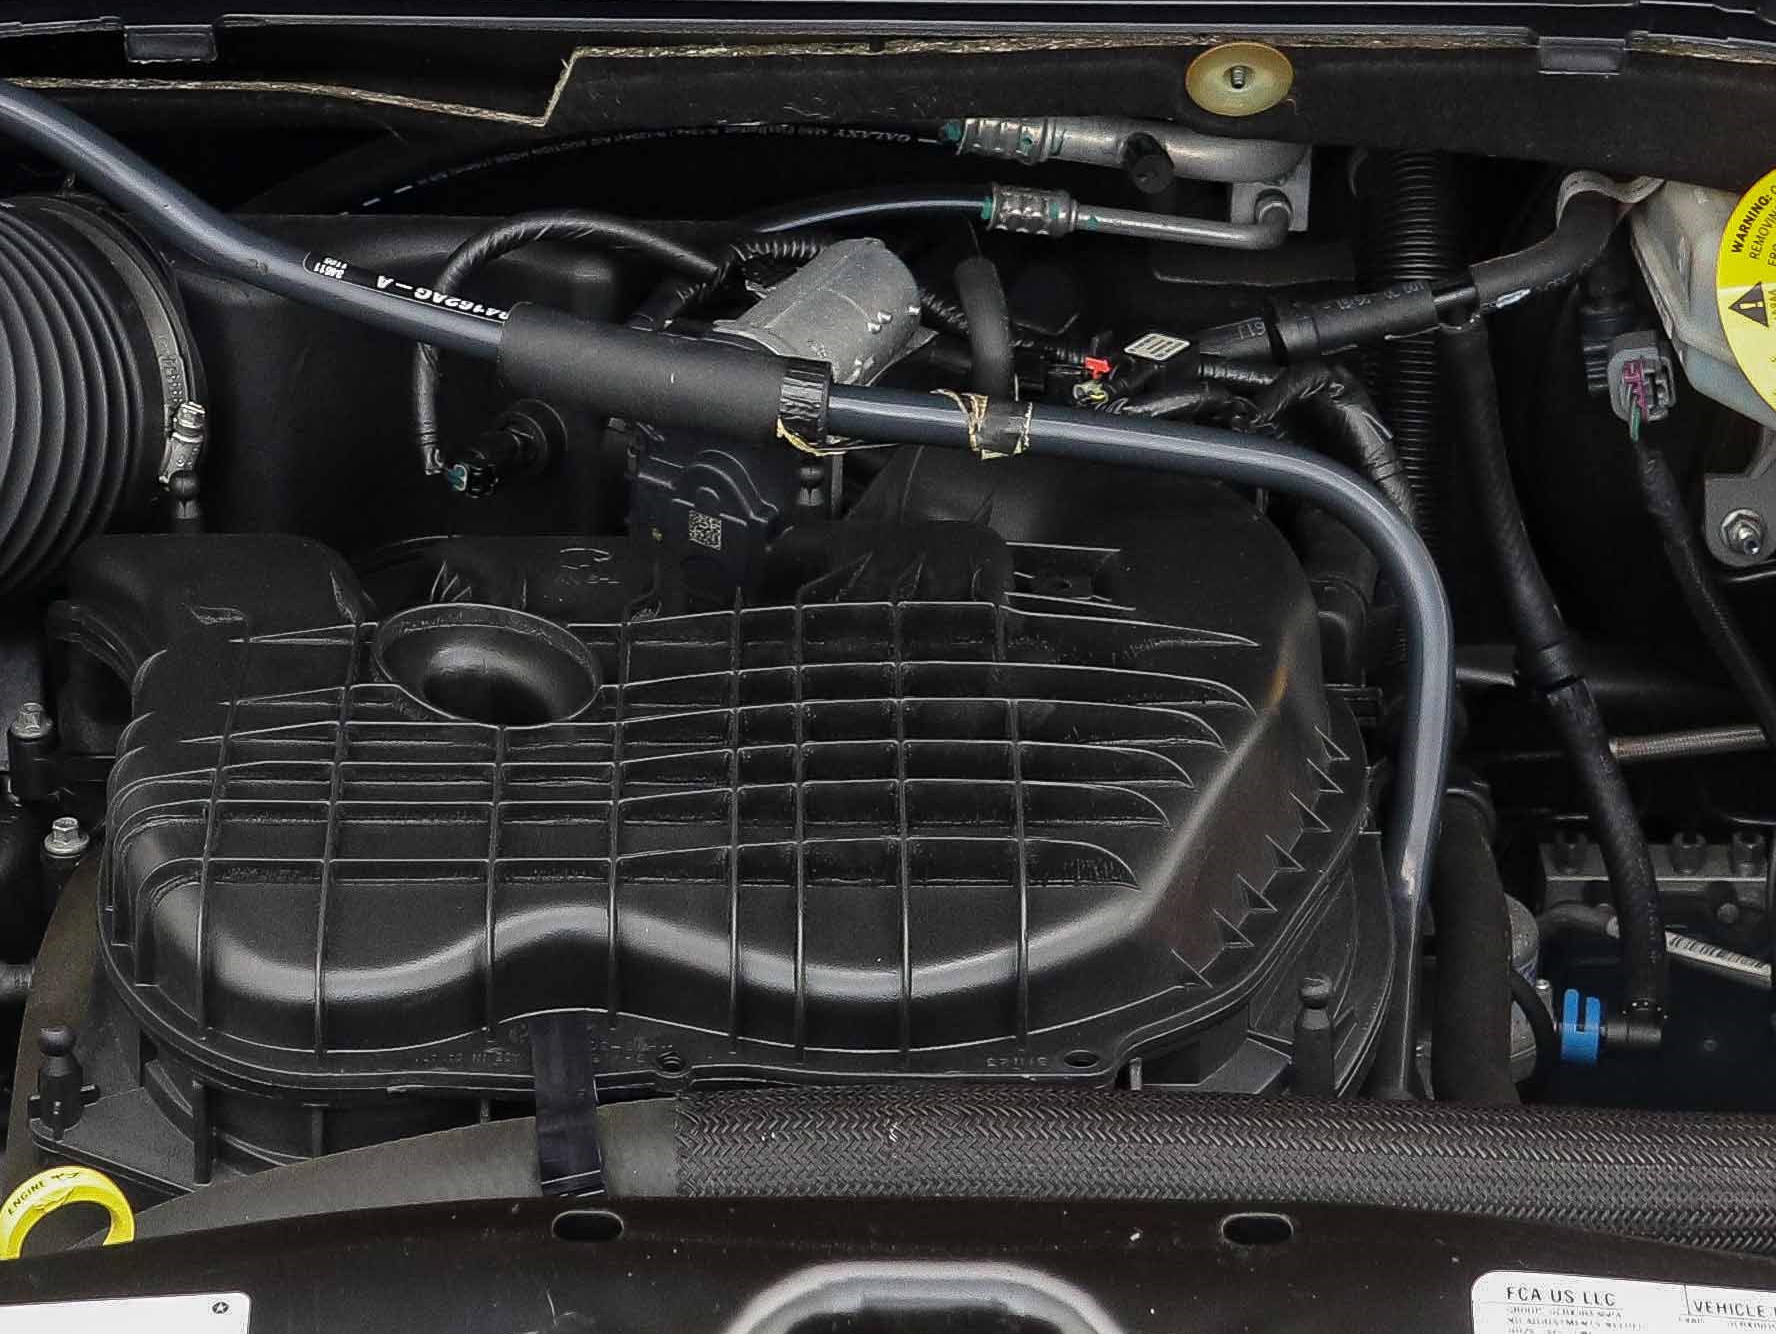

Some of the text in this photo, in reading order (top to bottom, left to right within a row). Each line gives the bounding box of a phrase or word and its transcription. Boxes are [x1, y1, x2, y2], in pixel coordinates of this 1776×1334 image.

[1731, 194, 1772, 254] WARNING:
[9, 1179, 46, 1217] ENGINE
[1506, 1286, 1617, 1307] FCA US LLC
[1693, 1299, 1766, 1318] VEHICLE
